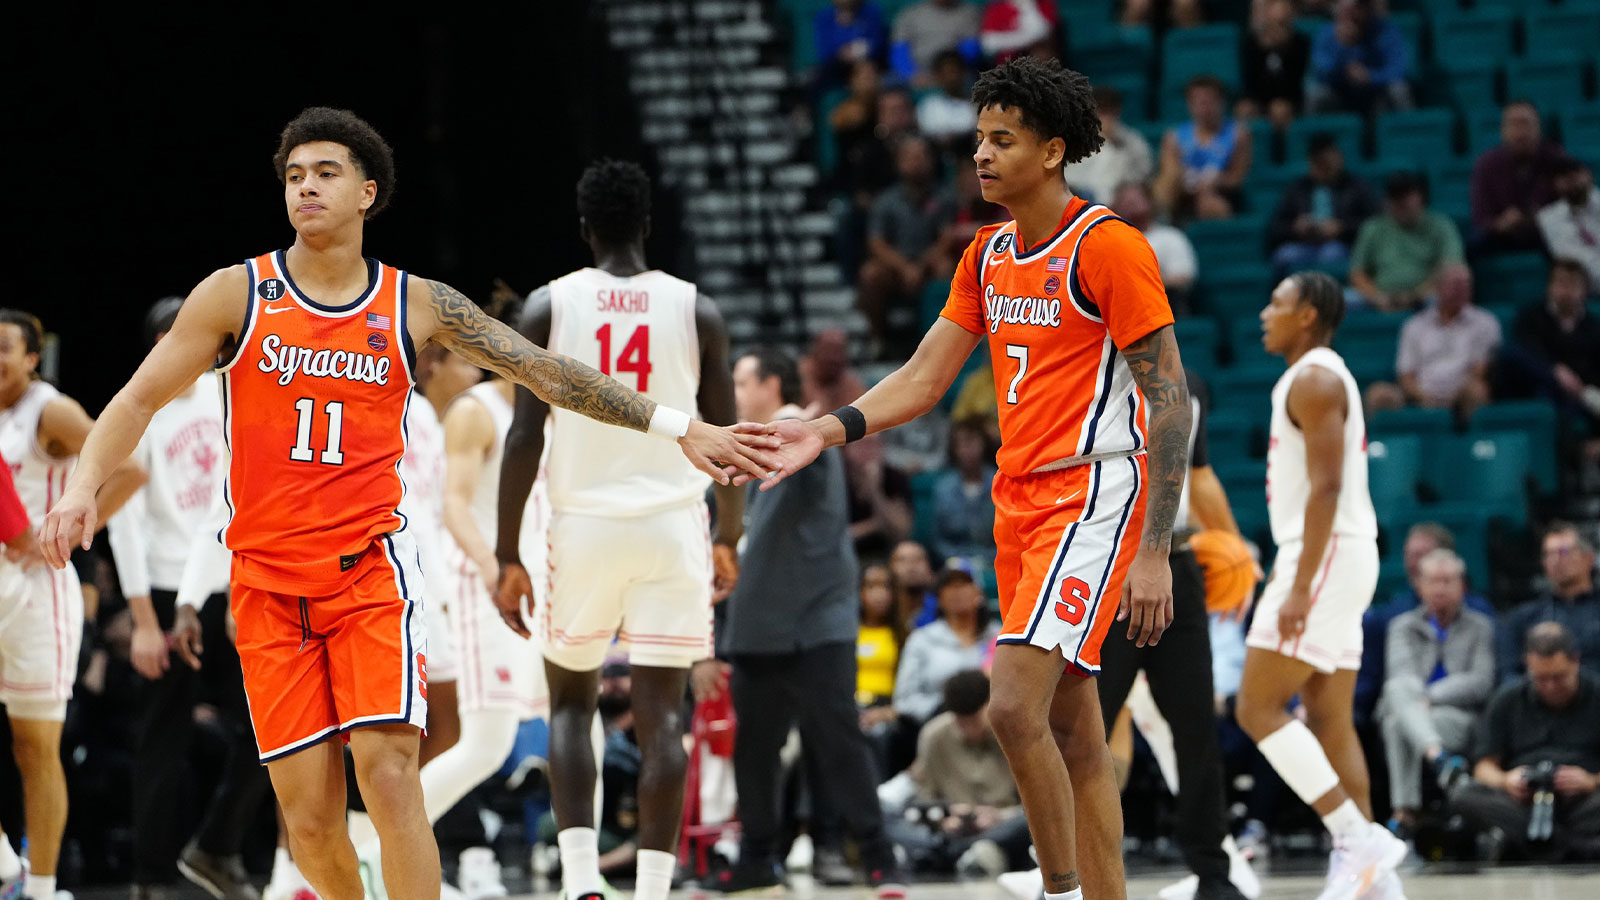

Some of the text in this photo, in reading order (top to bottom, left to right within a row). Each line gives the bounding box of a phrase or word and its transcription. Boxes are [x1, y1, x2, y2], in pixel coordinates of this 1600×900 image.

[266, 280, 277, 288] LM
[266, 288, 277, 299] 21
[596, 289, 649, 313] SAKHO
[984, 283, 1061, 334] Syracuse
[257, 334, 391, 386] Syracuse
[595, 323, 653, 393] 14
[1006, 343, 1029, 405] 7
[289, 397, 344, 465] 11
[1054, 575, 1091, 626] S
